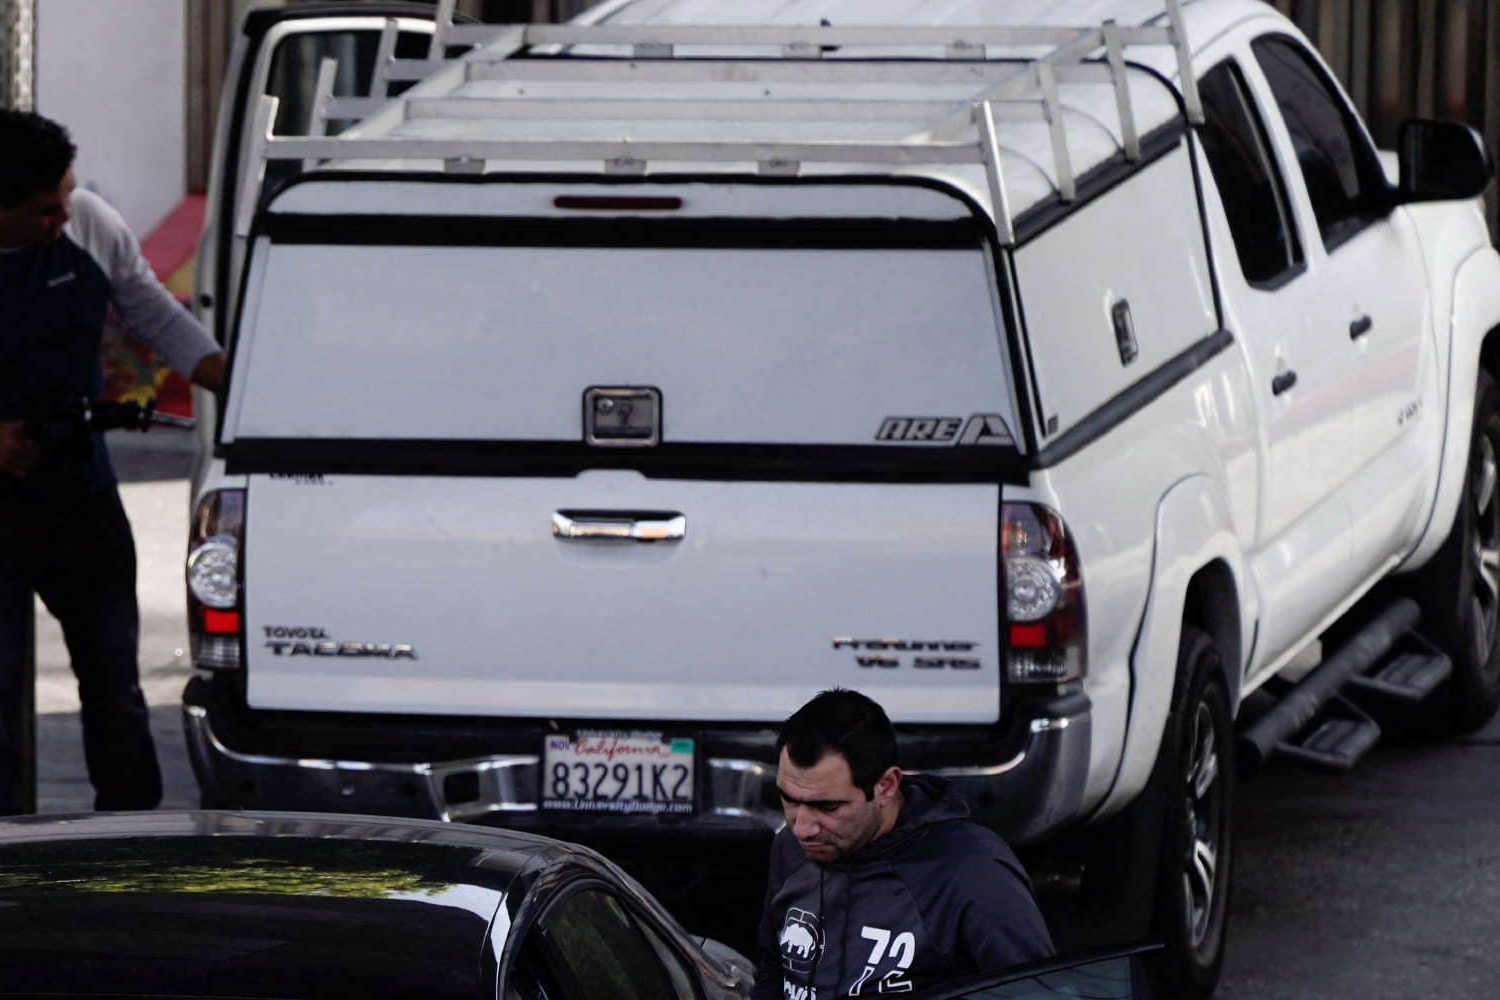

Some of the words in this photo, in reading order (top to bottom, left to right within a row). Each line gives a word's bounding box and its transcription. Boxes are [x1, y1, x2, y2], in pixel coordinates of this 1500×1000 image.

[263, 625, 329, 640] TOYOTA
[265, 641, 418, 660] TACOMA
[550, 740, 571, 751] NOV
[574, 736, 671, 761] California
[553, 762, 689, 801] 83291K2
[542, 799, 693, 815] www.UniversityDodge.com
[848, 925, 916, 997] 72
